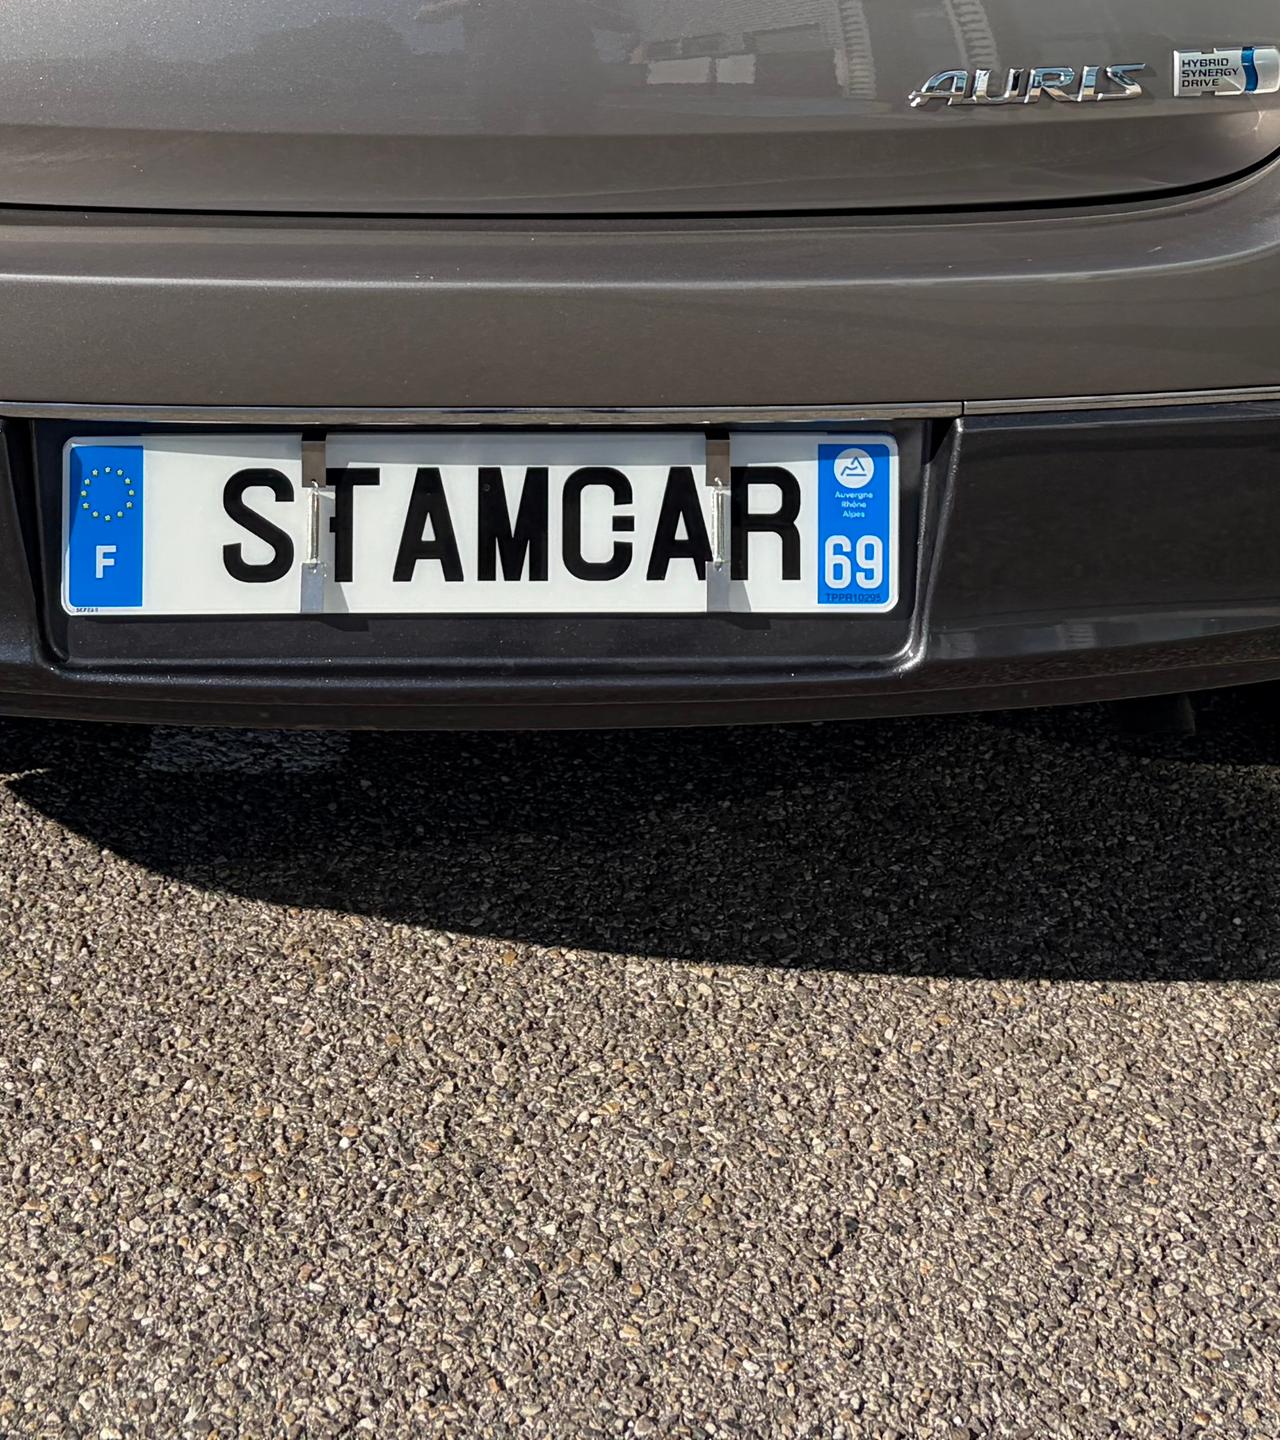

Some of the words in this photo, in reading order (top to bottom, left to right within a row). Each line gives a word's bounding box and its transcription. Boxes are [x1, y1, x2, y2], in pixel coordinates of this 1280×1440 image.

[1181, 57, 1230, 68] HYBRID
[1181, 67, 1240, 78] SYNERGY
[908, 62, 1148, 109] AURIS
[1181, 78, 1220, 88] DRIVE
[834, 490, 874, 500] Auvergne
[842, 510, 866, 519] Alpes
[220, 465, 803, 584] STAMCAR
[94, 544, 117, 580] F
[824, 534, 884, 590] 69
